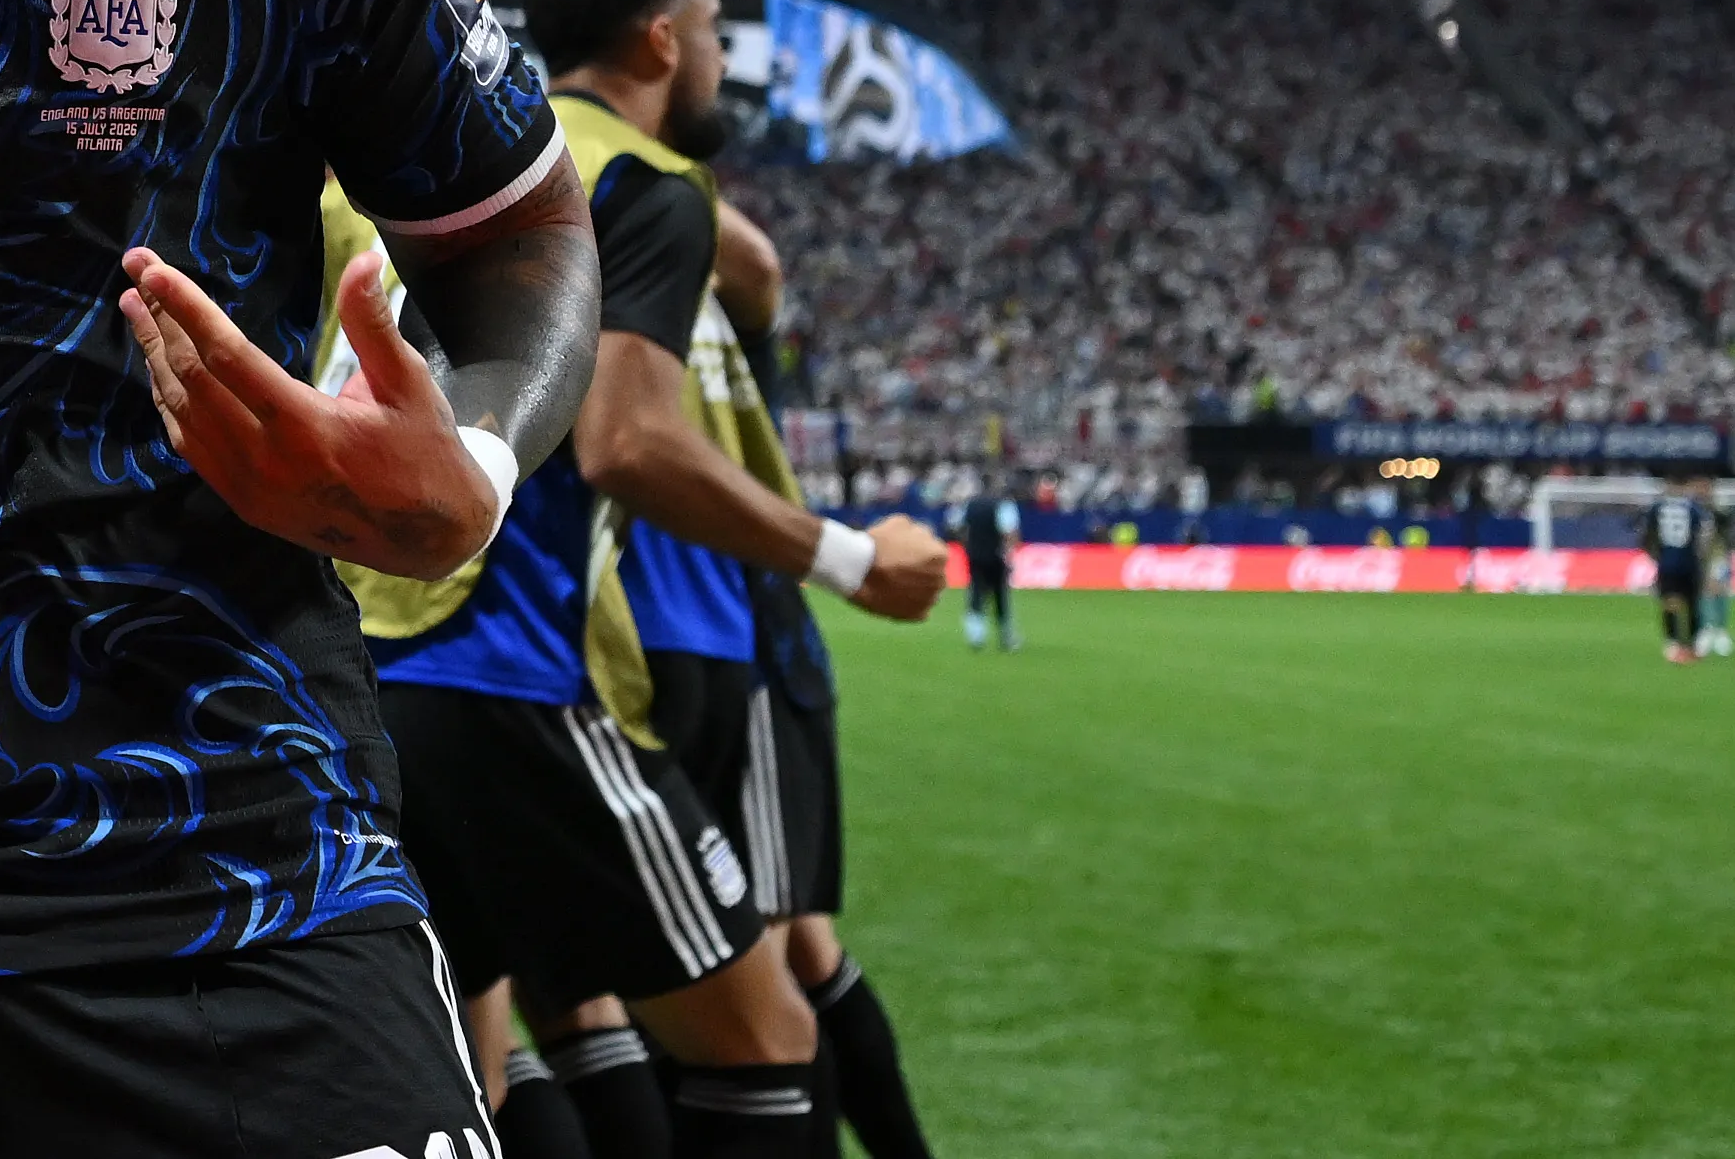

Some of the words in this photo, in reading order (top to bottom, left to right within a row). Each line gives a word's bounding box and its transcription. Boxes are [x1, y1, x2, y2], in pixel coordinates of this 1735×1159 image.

[40, 107, 89, 121] ENGLAND
[92, 107, 106, 120] VS
[109, 107, 165, 121] ARGENTINA
[66, 122, 77, 134] 15
[80, 122, 106, 135] JULY
[109, 123, 137, 136] 2026
[76, 138, 123, 151] ATLANTA
